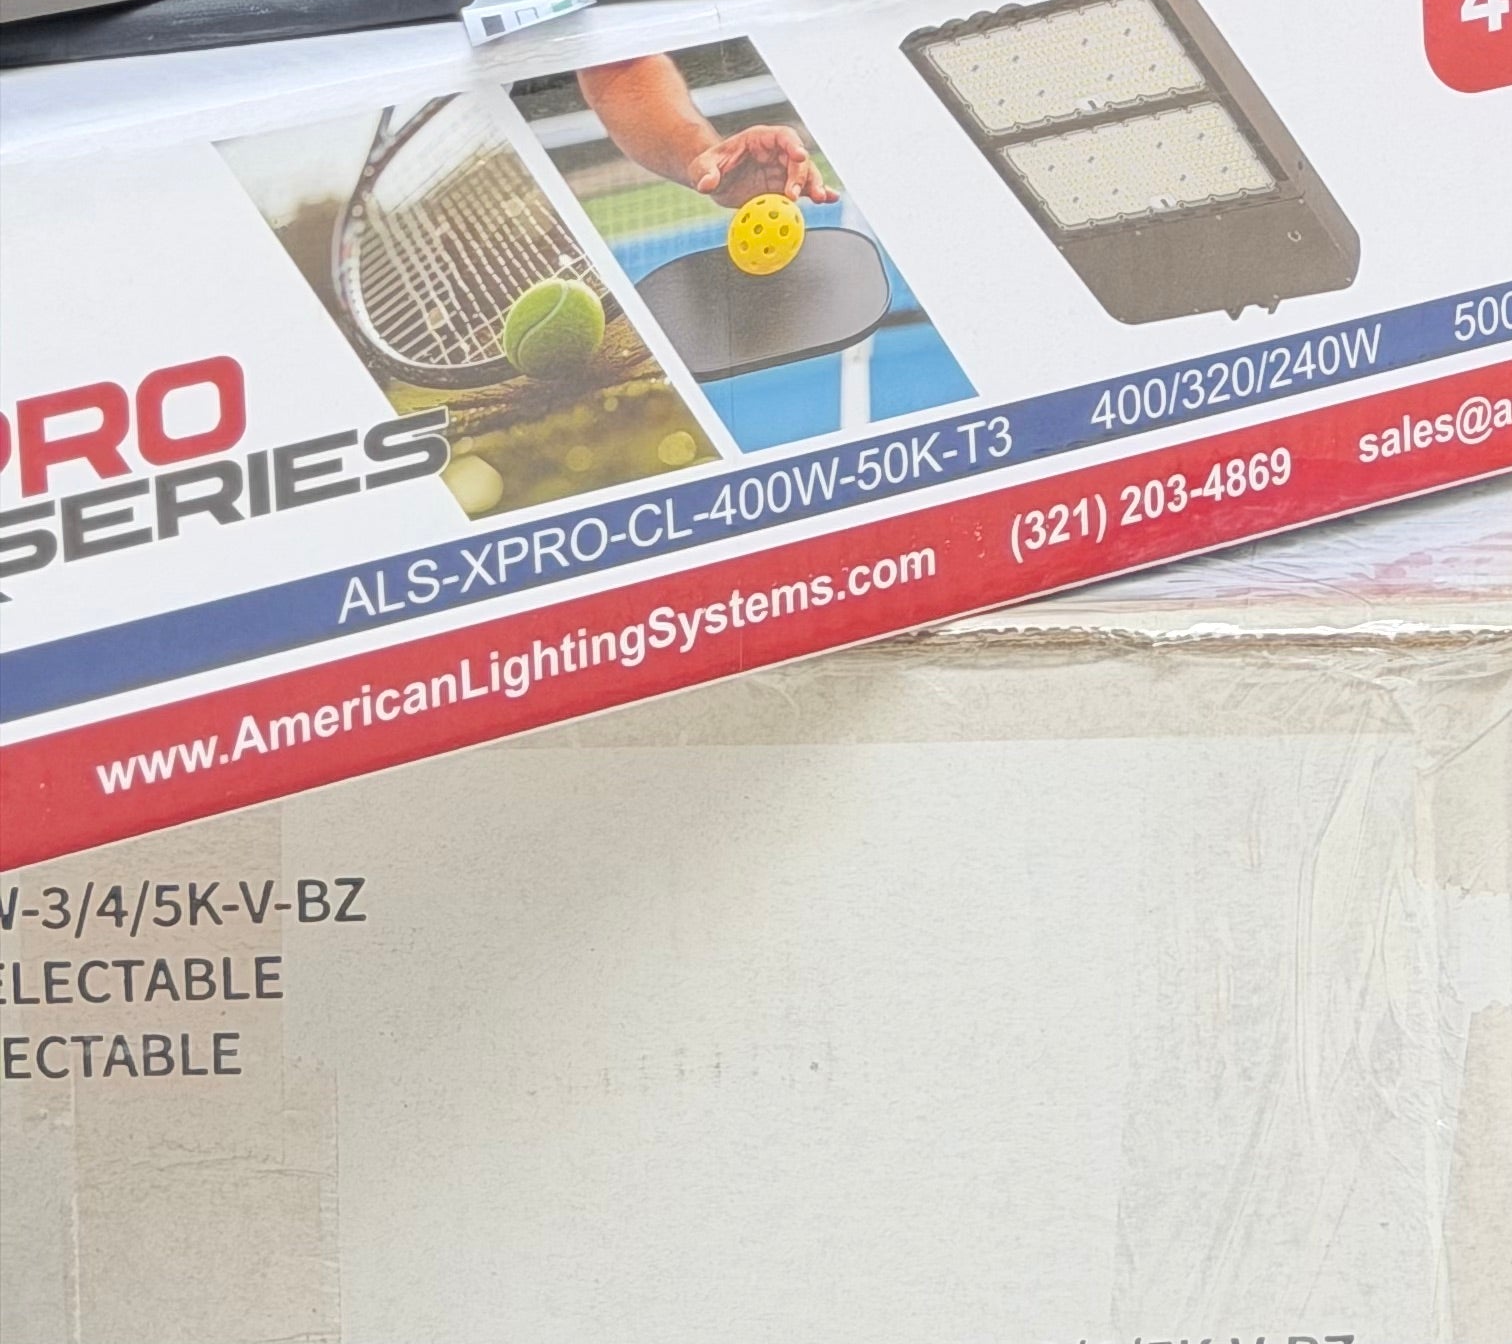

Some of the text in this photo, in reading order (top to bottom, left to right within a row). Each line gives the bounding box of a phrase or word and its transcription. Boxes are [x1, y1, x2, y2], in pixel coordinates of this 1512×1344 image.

[0, 355, 246, 498] RO
[0, 407, 449, 578] SERIES
[338, 416, 1013, 624] ALS-XPRO-CL-400W-50K-T3
[1090, 324, 1382, 430] 400/320/240W
[96, 546, 936, 795] www.AmericanLightingSystems.com
[1010, 493, 1107, 563] (321)
[1120, 446, 1292, 525] 203-4869
[0, 956, 284, 1005] LECTABLE
[4, 1032, 242, 1079] ECTABLE
